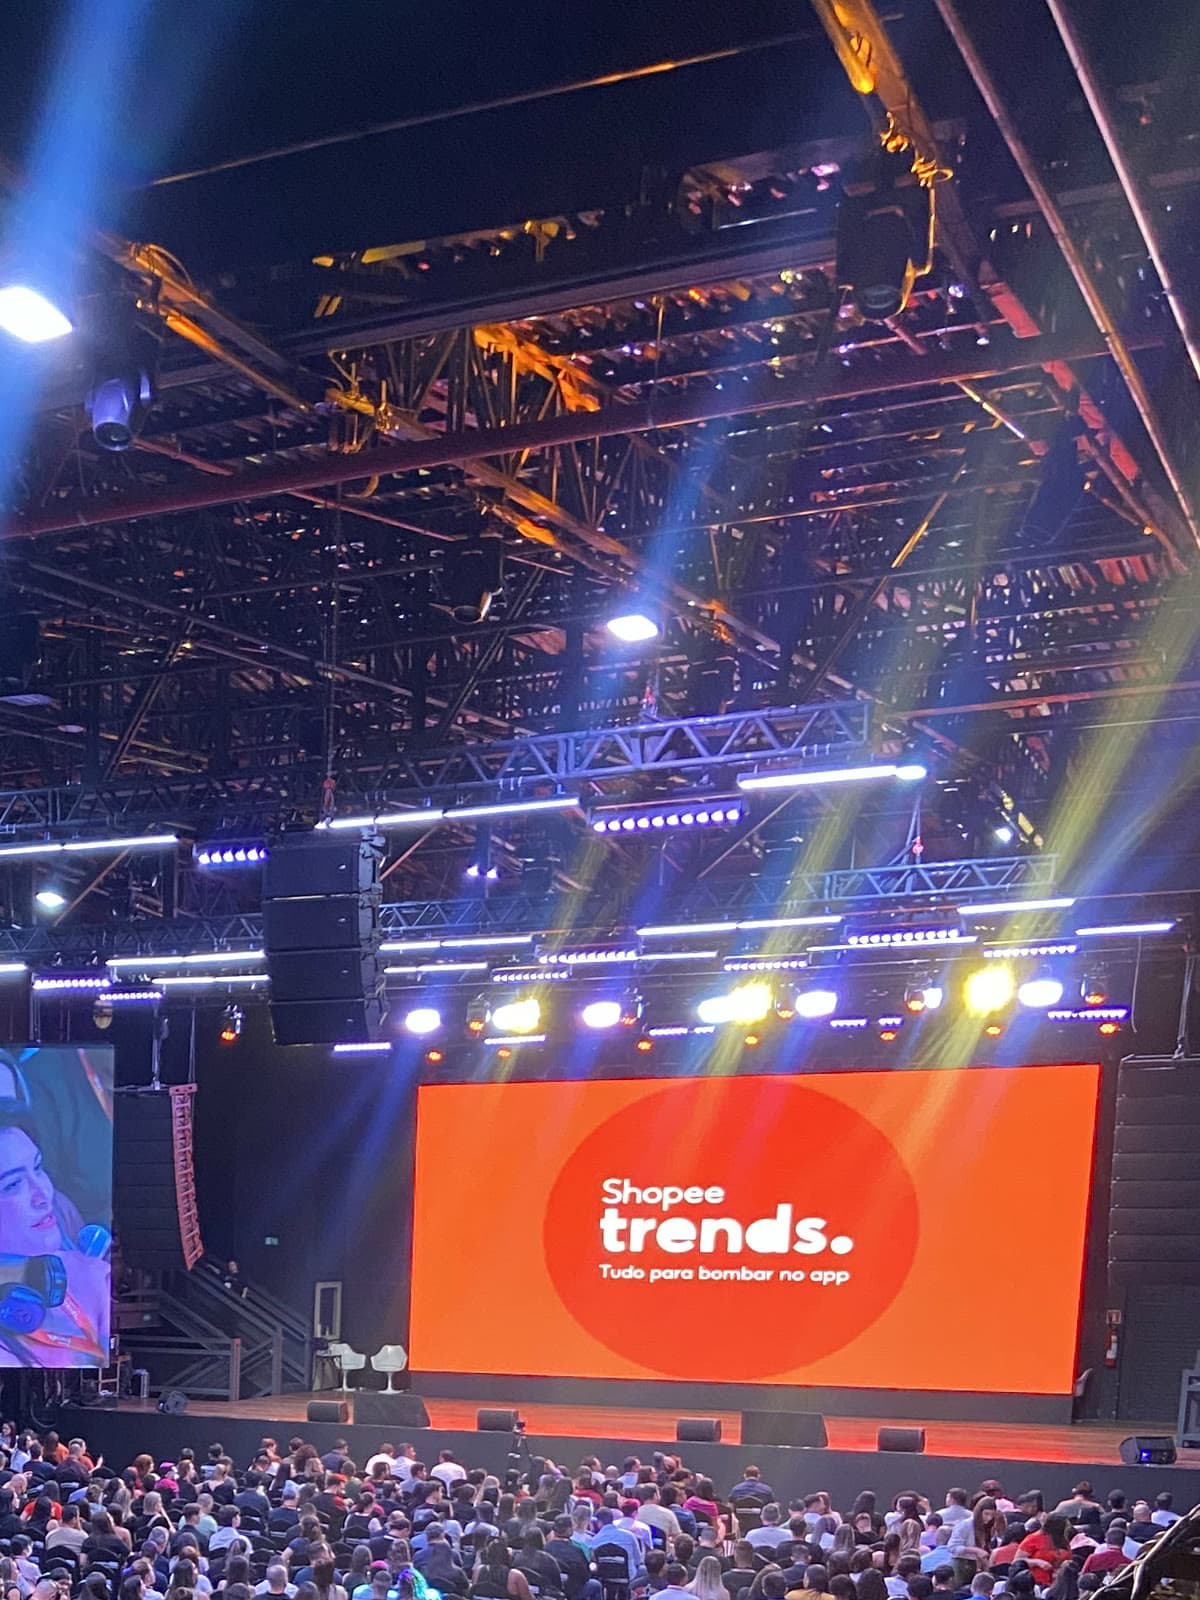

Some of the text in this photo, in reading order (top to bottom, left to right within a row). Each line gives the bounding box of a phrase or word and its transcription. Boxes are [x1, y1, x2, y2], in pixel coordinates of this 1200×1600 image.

[601, 1178, 725, 1211] Shopee
[599, 1203, 854, 1254] trends.
[598, 1264, 850, 1286] Tudo para bombar no app
